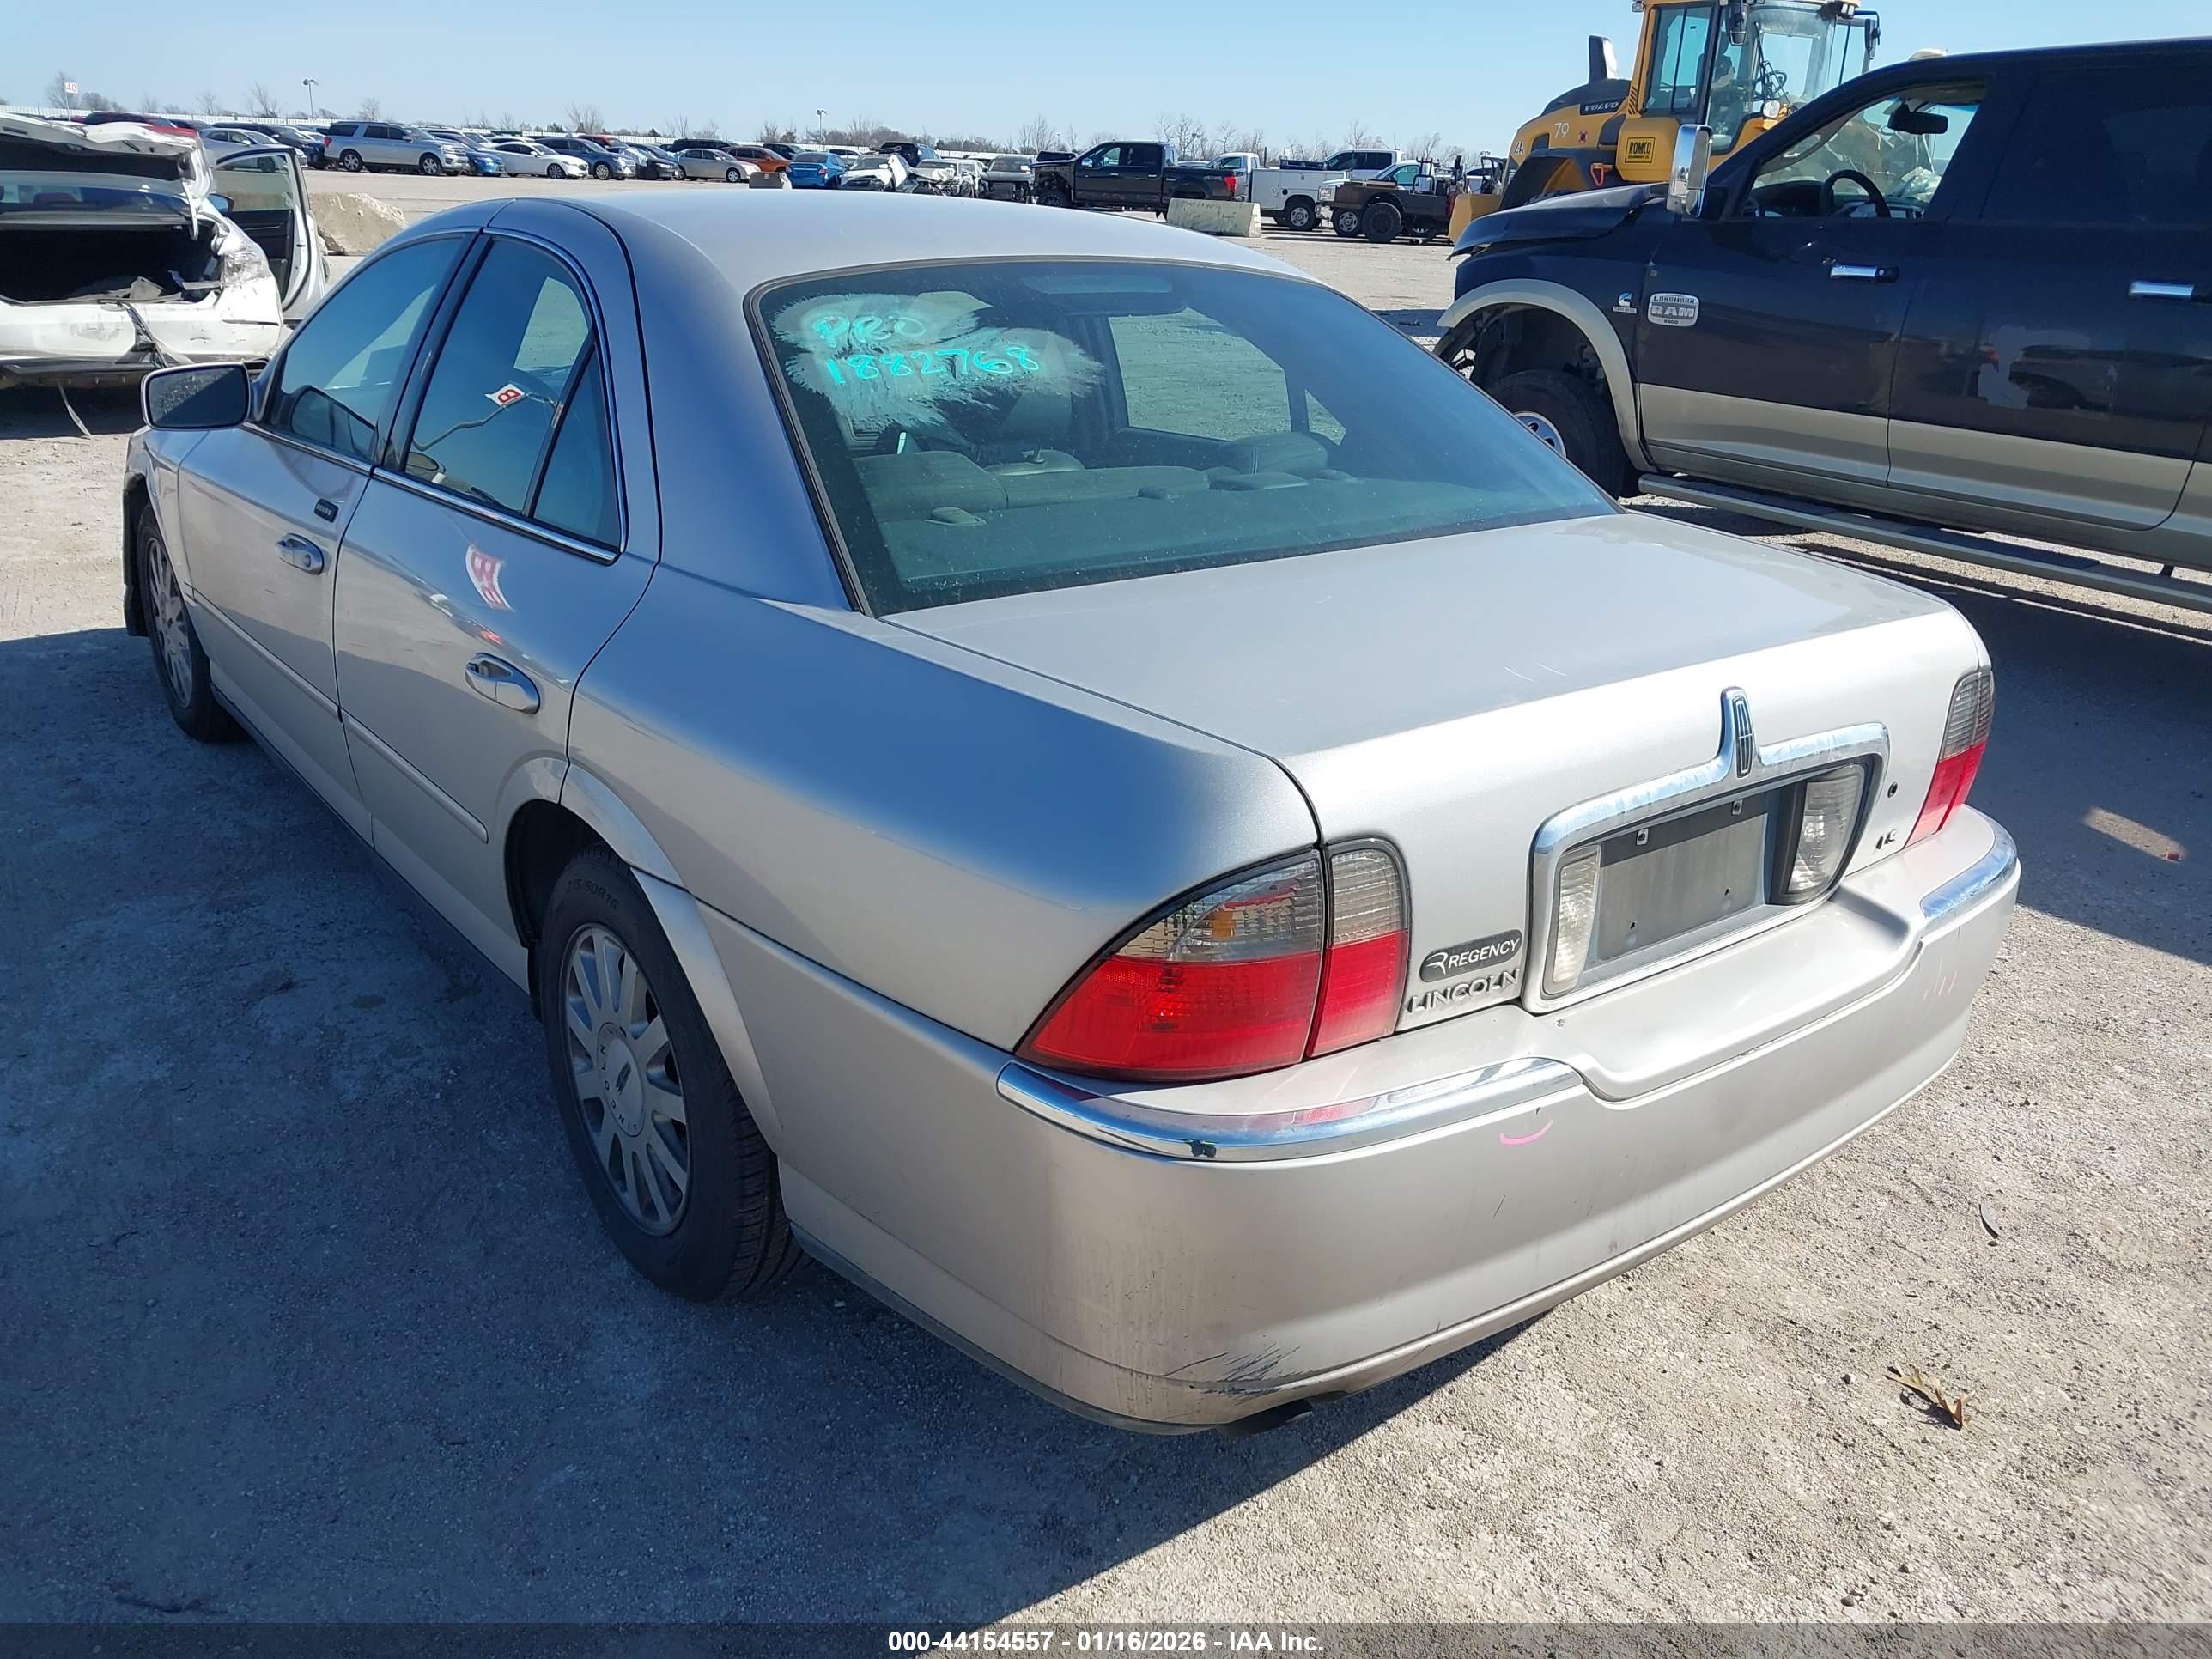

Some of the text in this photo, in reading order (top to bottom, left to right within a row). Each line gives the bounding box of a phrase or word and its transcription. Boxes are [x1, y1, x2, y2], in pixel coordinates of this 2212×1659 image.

[1584, 101, 1620, 112] VOLVO
[1554, 122, 1570, 138] 79
[1628, 141, 1651, 155] ROMCO
[1650, 305, 1695, 318] RAM
[825, 346, 1040, 385] 1882768
[498, 389, 520, 404] B
[1448, 937, 1521, 969] REGENCY
[1407, 968, 1520, 1013] LINCOLN
